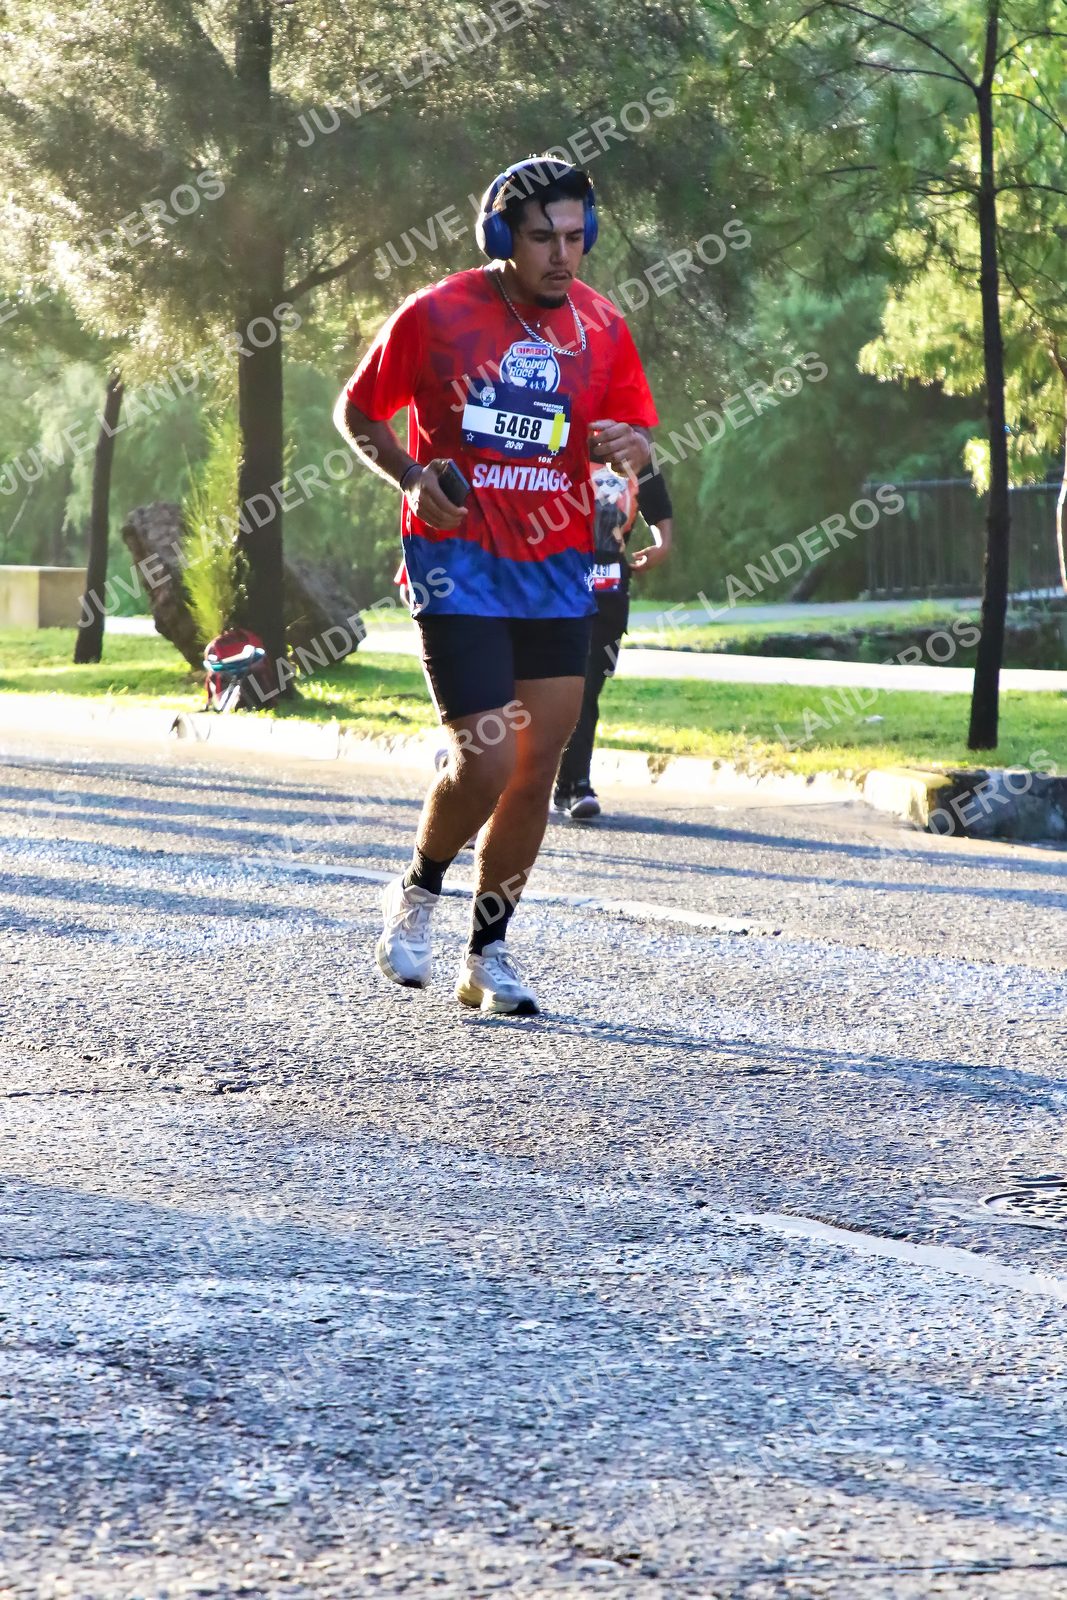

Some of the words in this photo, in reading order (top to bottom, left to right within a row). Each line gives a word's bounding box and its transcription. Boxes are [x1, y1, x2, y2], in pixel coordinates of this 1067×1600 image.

[515, 357, 547, 370] Global
[509, 366, 535, 378] Race
[494, 411, 542, 441] 5468
[538, 456, 553, 464] 10K
